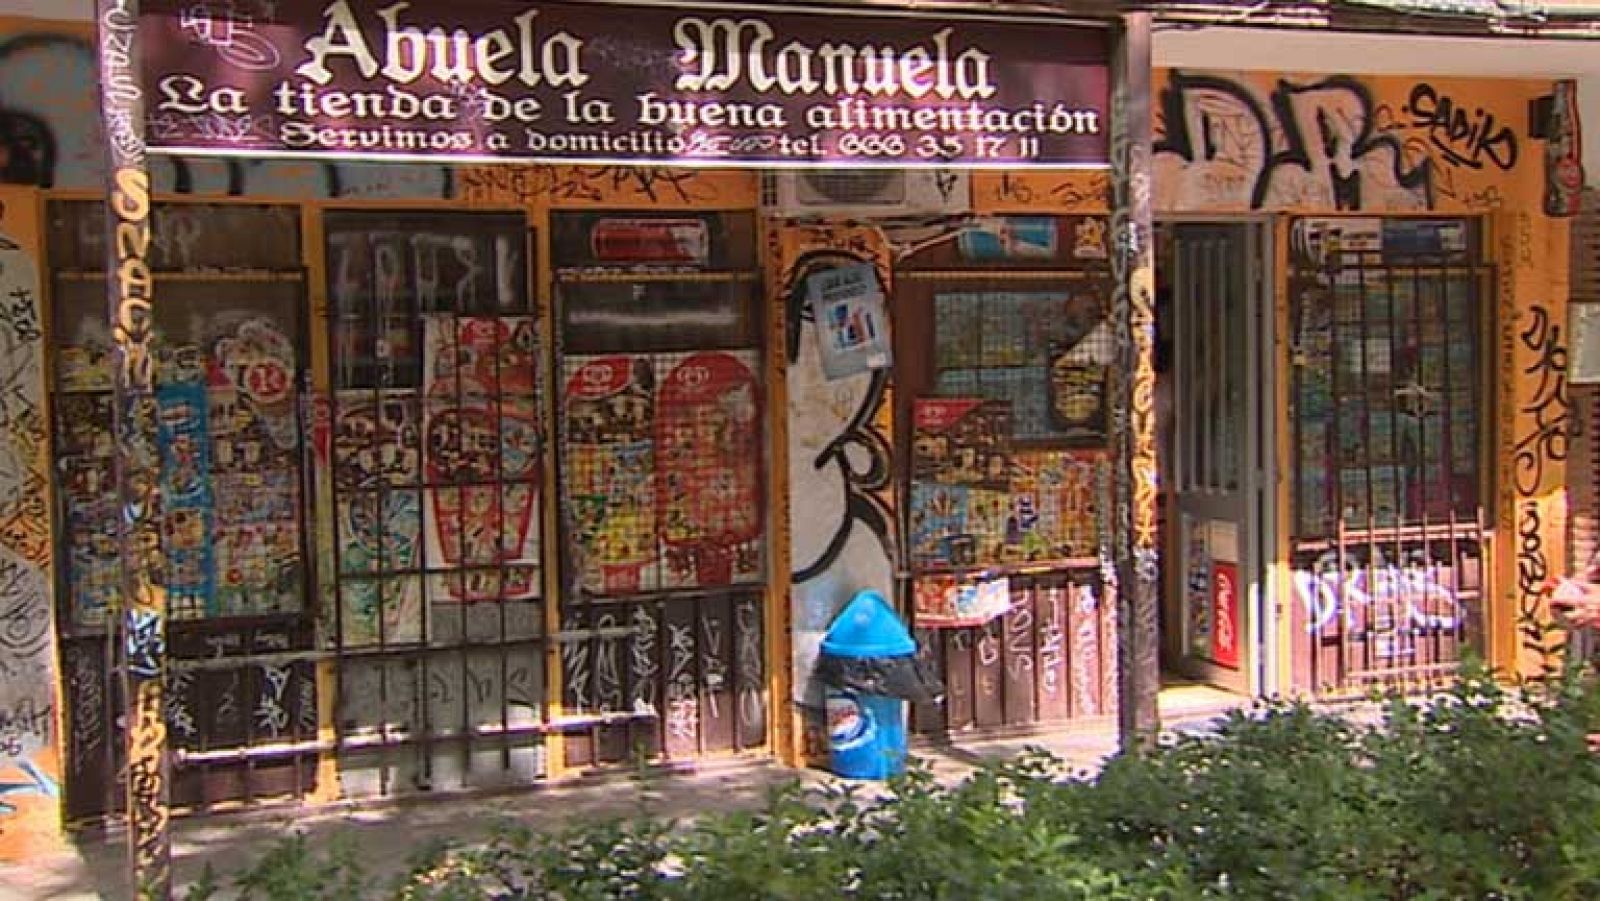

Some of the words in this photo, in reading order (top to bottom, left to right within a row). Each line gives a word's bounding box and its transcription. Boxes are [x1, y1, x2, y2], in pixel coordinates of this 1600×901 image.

[297, 1, 588, 87] Abuela
[675, 18, 997, 97] Manuela
[159, 75, 247, 114] La
[275, 82, 456, 118] tienda
[480, 91, 542, 122] de
[565, 90, 613, 124] la
[638, 94, 785, 127] buena
[806, 98, 1099, 133] alimentación
[280, 122, 472, 150] Servimos
[486, 133, 510, 151] a
[839, 133, 905, 156] 666
[916, 135, 963, 158] 35
[976, 136, 1005, 158] 17
